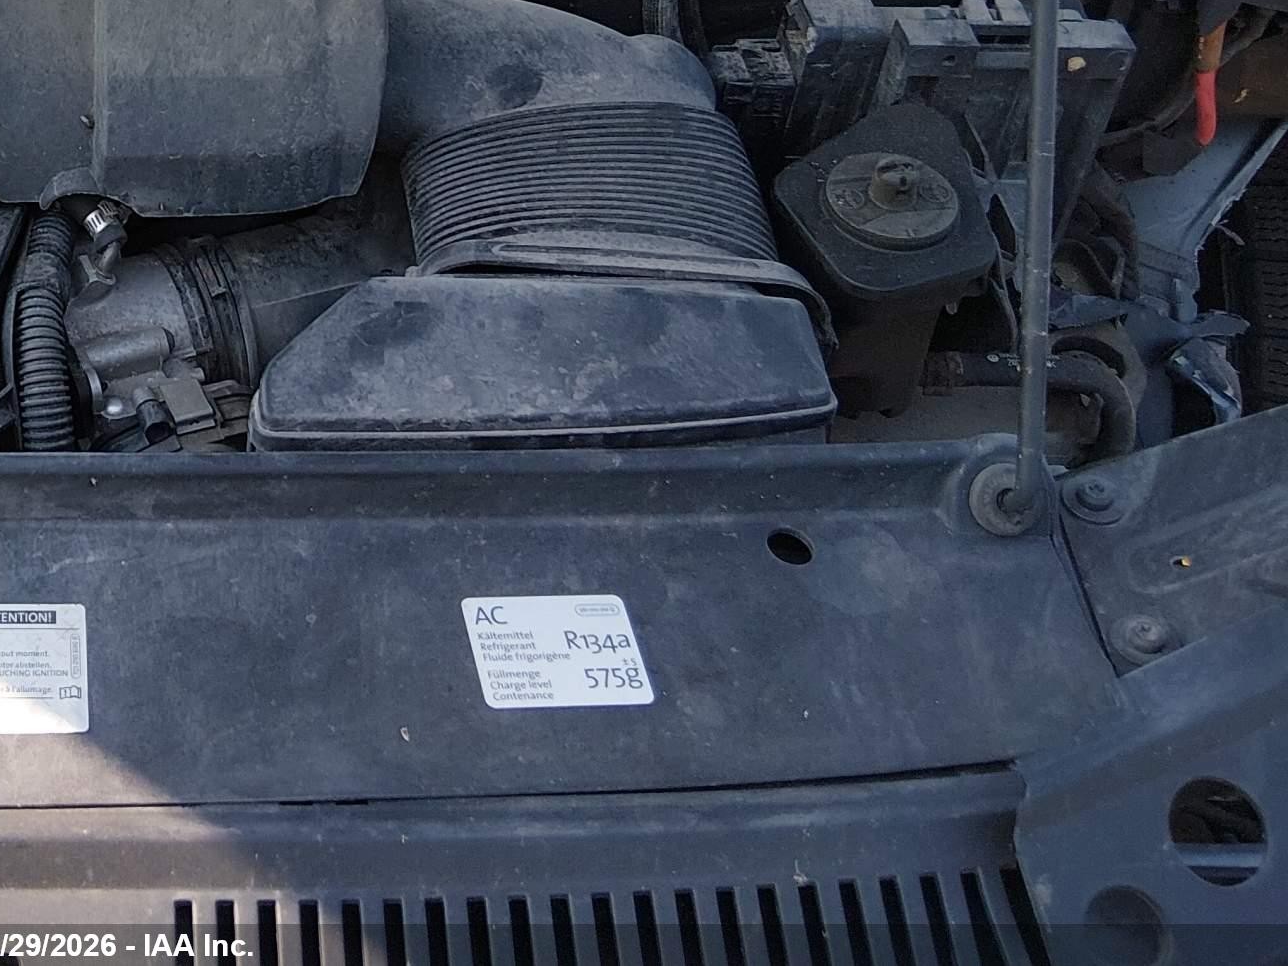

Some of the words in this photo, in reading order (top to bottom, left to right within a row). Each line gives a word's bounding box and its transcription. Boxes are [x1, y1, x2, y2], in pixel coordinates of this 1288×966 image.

[475, 606, 508, 625] AC
[480, 642, 536, 652] Refrigerant
[563, 630, 631, 654] R134a
[483, 652, 513, 662] Fluide
[32, 669, 68, 677] IGNITION
[487, 669, 541, 680] Füllmenge
[584, 667, 643, 689] 575g
[490, 681, 526, 691] Charge
[528, 680, 553, 689] level
[492, 692, 554, 700] Contenance
